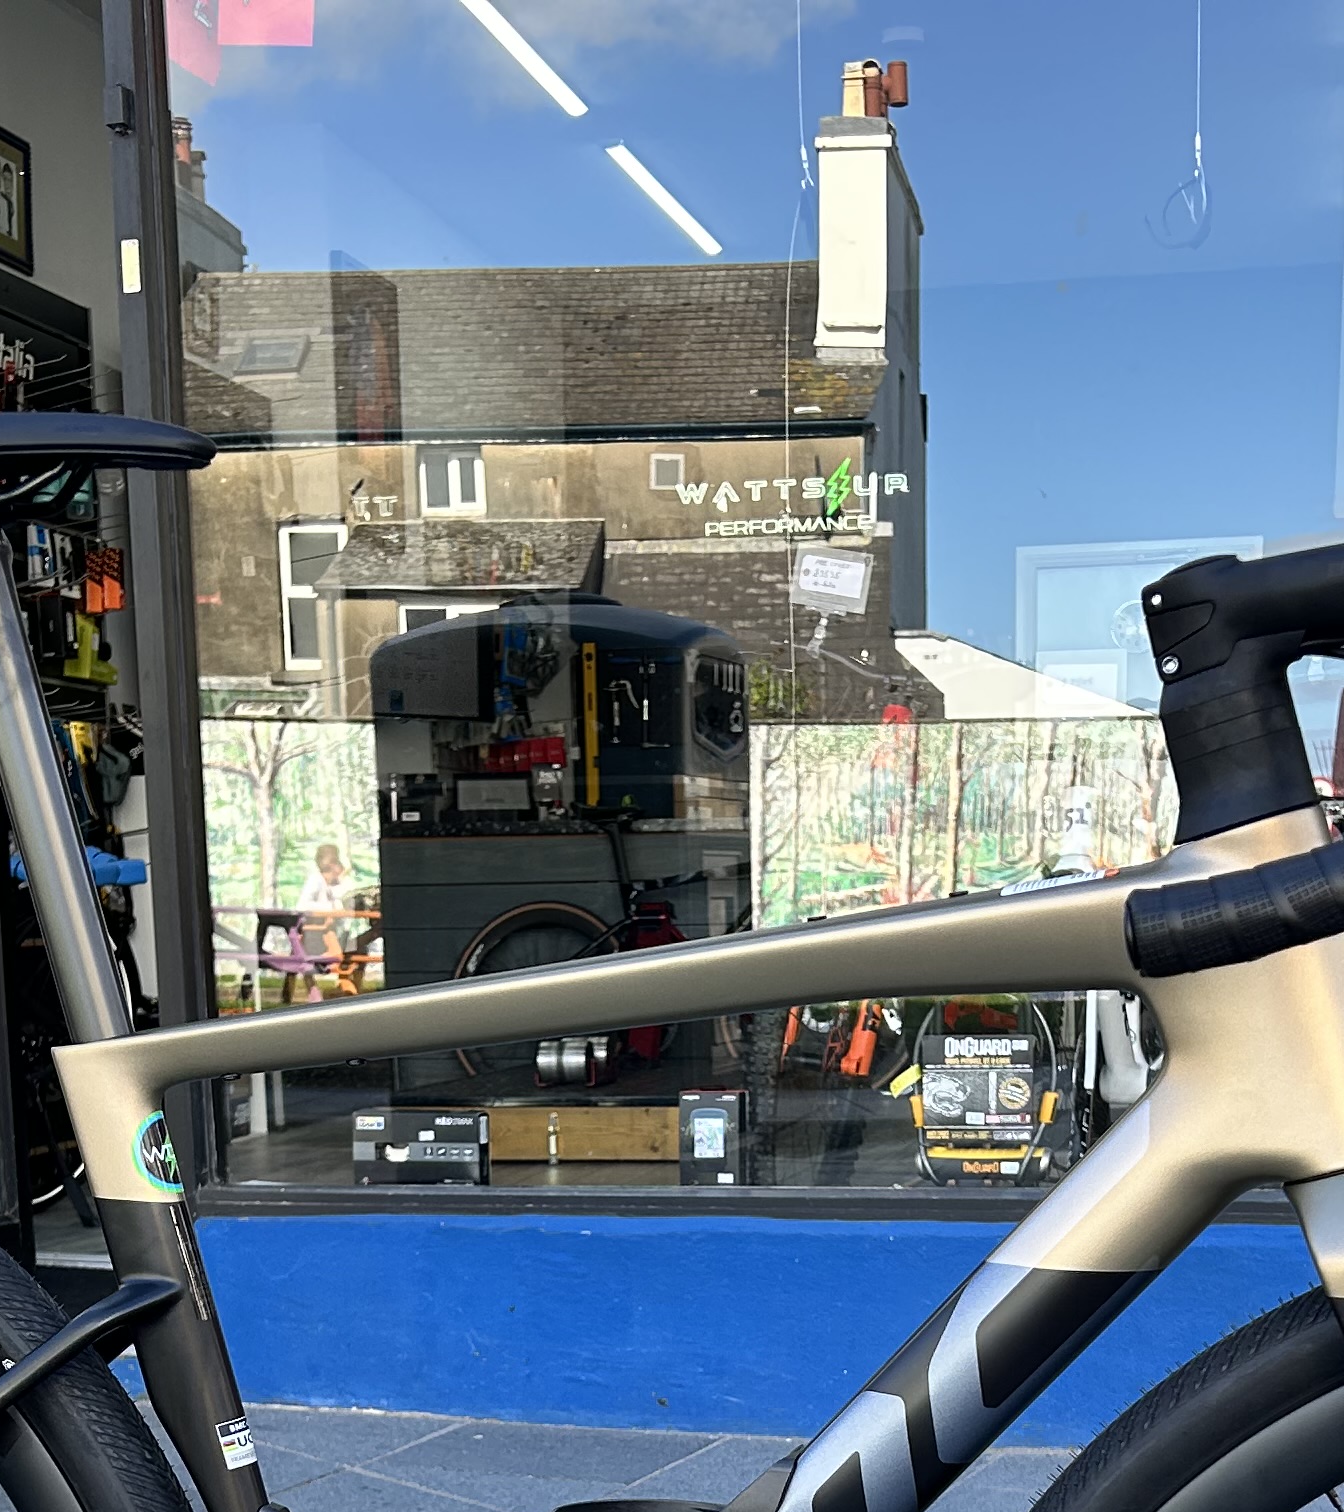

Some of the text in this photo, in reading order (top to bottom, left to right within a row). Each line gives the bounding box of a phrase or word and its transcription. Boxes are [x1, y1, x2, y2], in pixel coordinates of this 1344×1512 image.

[674, 472, 910, 505] WATTS UP
[704, 514, 873, 537] PERFORMANCE
